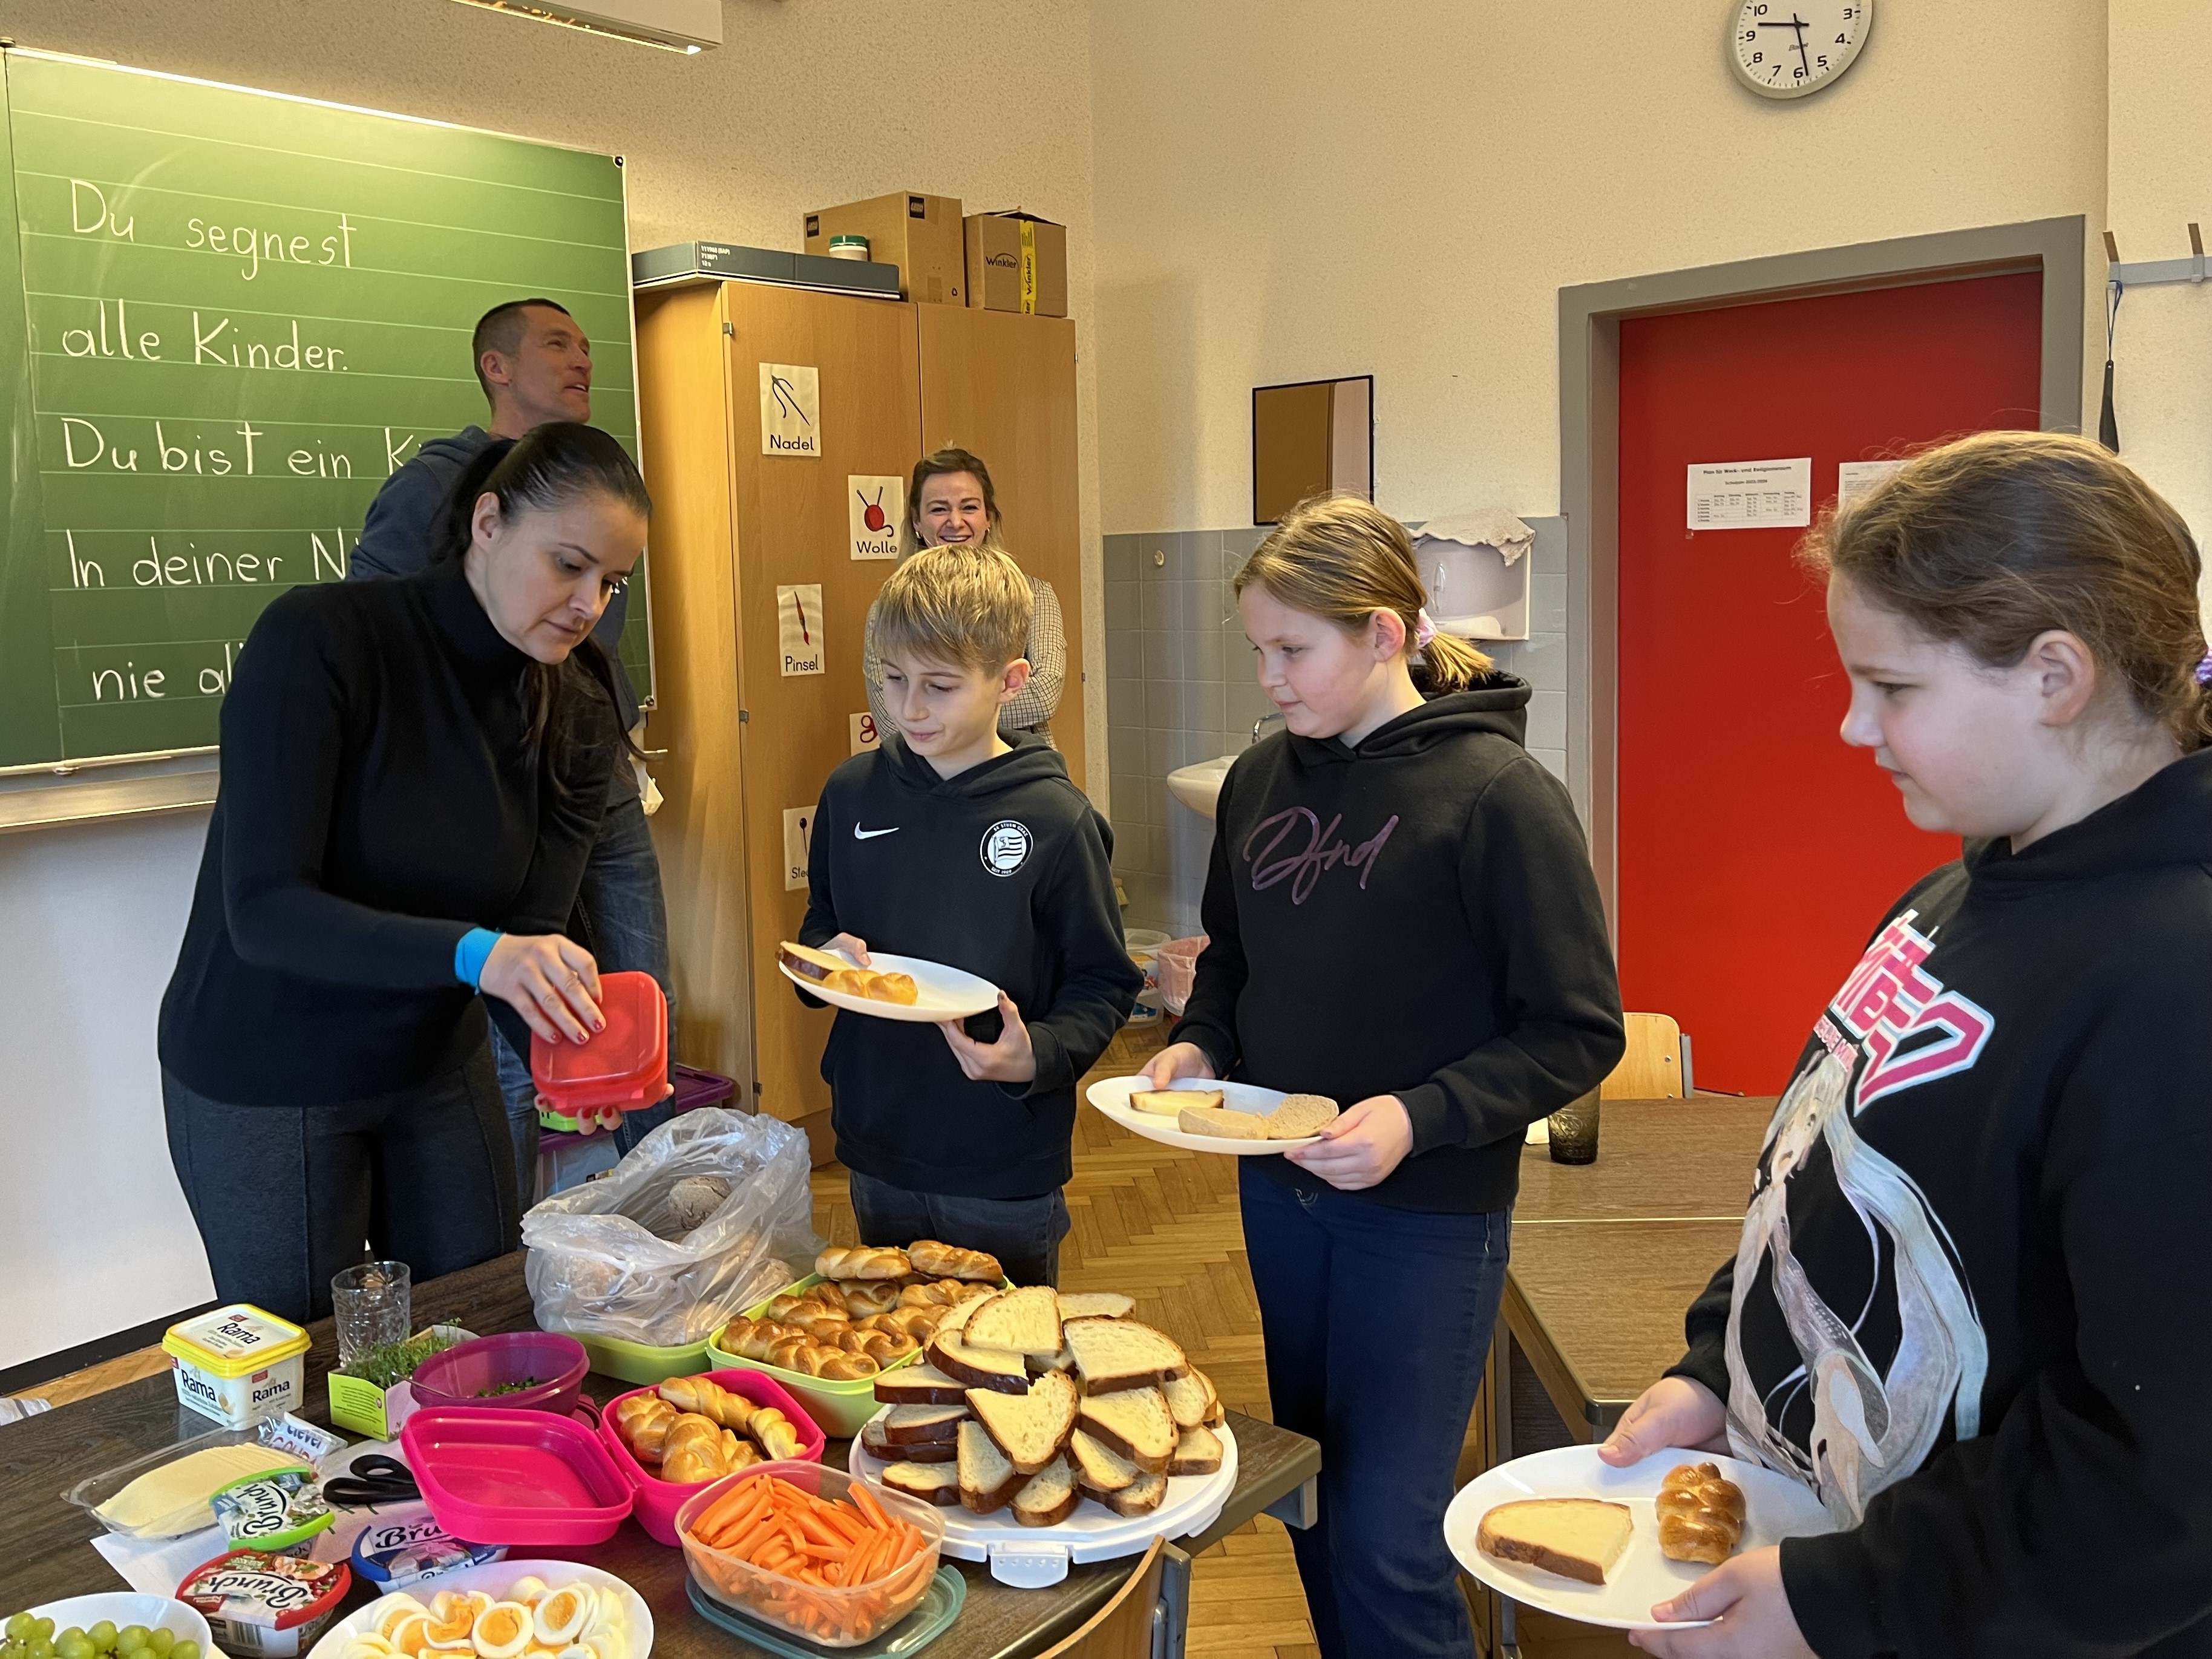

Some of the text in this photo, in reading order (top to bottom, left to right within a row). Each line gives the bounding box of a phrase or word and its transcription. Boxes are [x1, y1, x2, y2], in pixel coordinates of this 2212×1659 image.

[1754, 4, 1767, 16] 10
[1844, 8, 1853, 19] 3
[1746, 31, 1756, 41] 9
[1835, 33, 1845, 43] 4
[1753, 52, 1762, 63] 8
[1818, 56, 1827, 67] 5
[1773, 65, 1781, 76] 7
[1793, 67, 1803, 78] 6
[70, 179, 357, 280] Du segnest
[986, 256, 1017, 269] Winkler
[62, 298, 348, 371] alle Kinder.
[61, 417, 422, 479] Du bist ein K
[770, 434, 814, 450] Nadel
[856, 541, 897, 553] Wolle
[66, 526, 359, 588] In deiner N
[785, 654, 819, 672] Pinsel
[93, 662, 165, 701] nie
[217, 1323, 261, 1344] Rama
[181, 1369, 217, 1402] Rama
[252, 1381, 290, 1402] Rama
[237, 1484, 284, 1535] Brunch
[209, 1576, 308, 1608] Brunch
